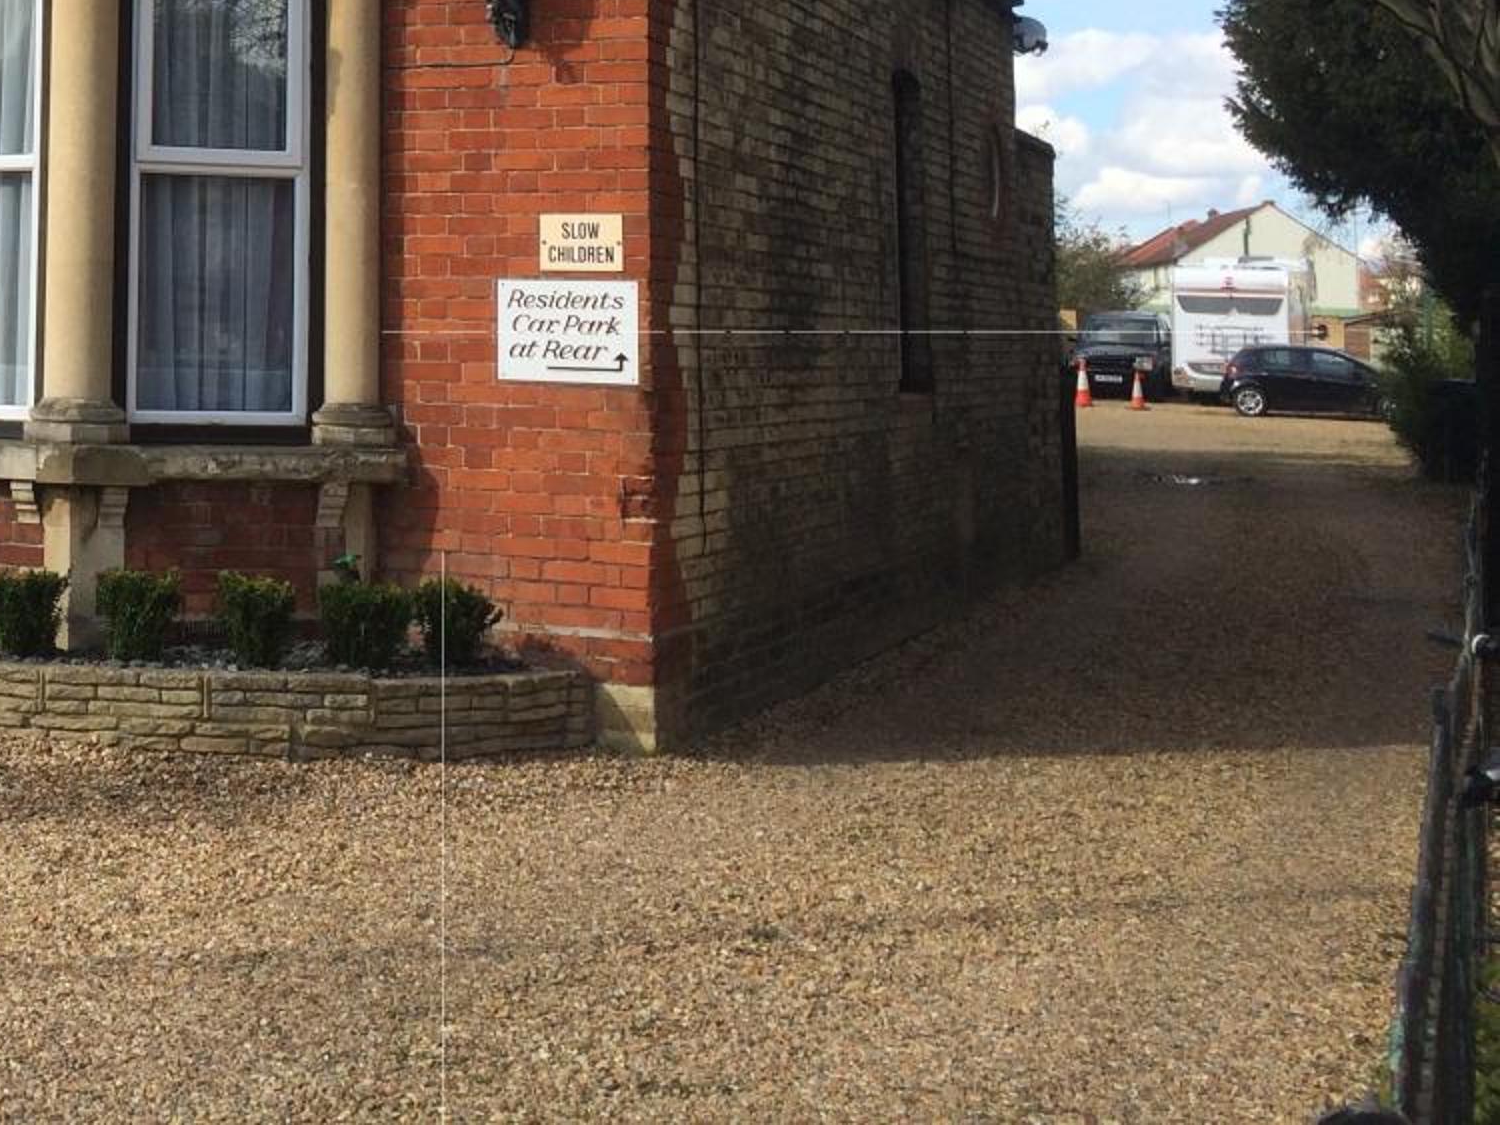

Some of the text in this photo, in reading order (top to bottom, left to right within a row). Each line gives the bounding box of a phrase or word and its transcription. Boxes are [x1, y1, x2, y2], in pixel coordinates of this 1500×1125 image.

[561, 222, 600, 240] SLOW
[548, 245, 615, 264] CHILDREN
[507, 288, 624, 310] Residents
[512, 314, 621, 336] Car Park
[509, 339, 608, 361] at Rear
